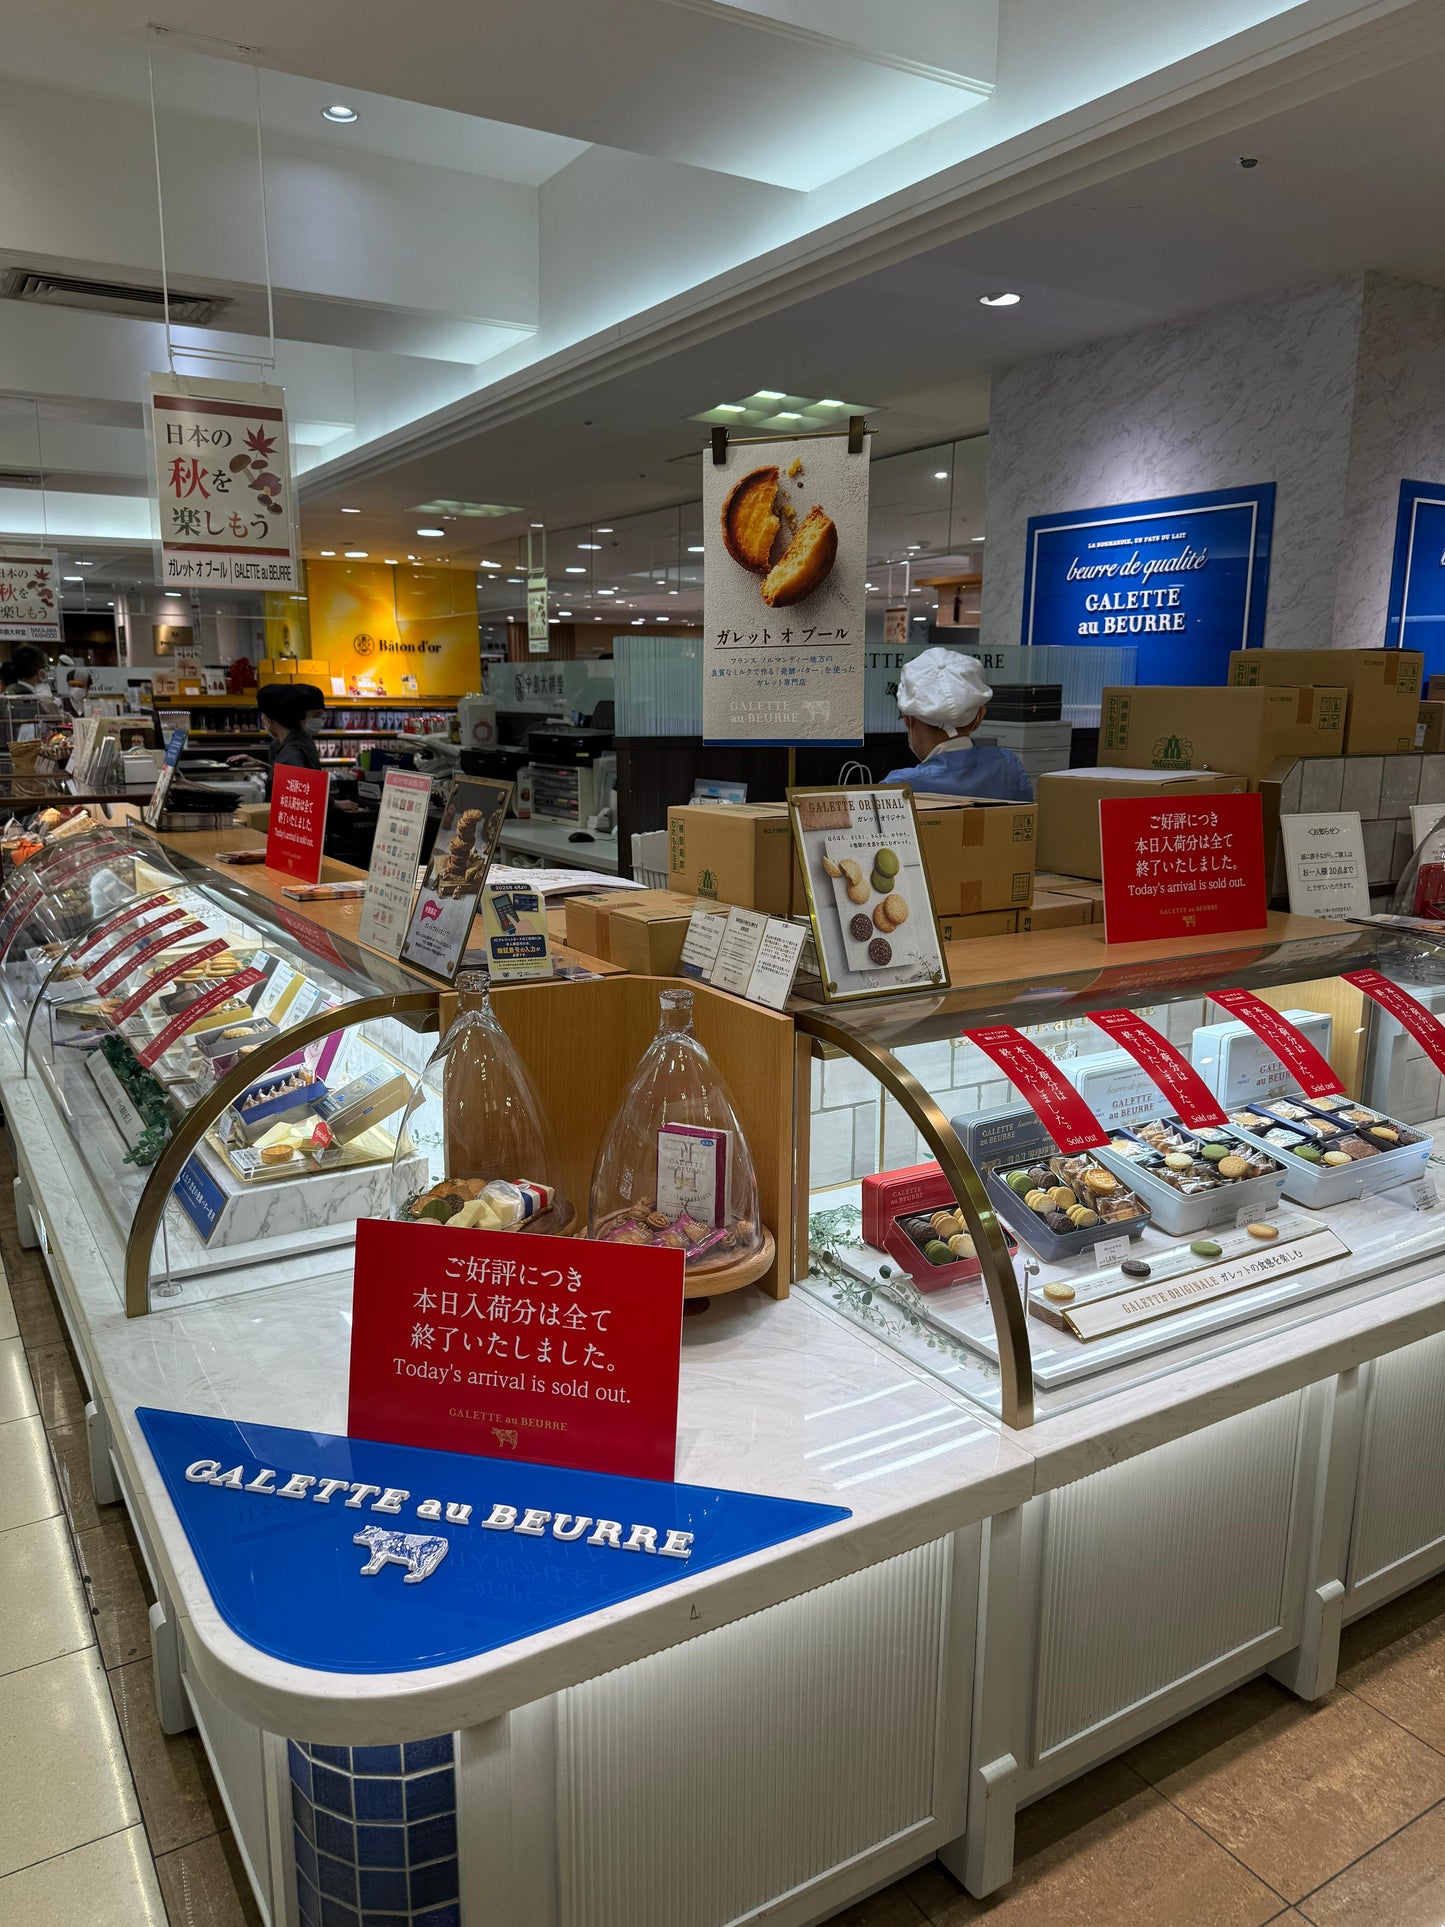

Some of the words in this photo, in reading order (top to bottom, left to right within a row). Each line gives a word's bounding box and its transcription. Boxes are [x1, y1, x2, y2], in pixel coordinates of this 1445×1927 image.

[166, 423, 232, 448] 日本の
[167, 456, 232, 499] 秋を
[172, 506, 269, 540] 楽しもう
[168, 559, 194, 577] ガレット
[196, 560, 203, 577] オ
[206, 560, 228, 578] ブール
[234, 563, 260, 580] GALETTE
[261, 567, 269, 580] au
[269, 565, 292, 581] BEURRE
[1066, 556, 1119, 581] beurre
[1119, 550, 1143, 576] de
[1142, 544, 1209, 584] qualité
[1084, 587, 1180, 612] GALETTE
[0, 605, 48, 619] 楽しもう
[1077, 619, 1099, 635] au
[1102, 612, 1186, 635] BEURRE
[379, 639, 416, 653] Bâton
[418, 640, 442, 653] d'or
[716, 628, 771, 646] ガレット
[781, 627, 793, 643] オ
[801, 626, 849, 643] ブール
[730, 701, 791, 711] GALETTE
[730, 715, 744, 723] au
[748, 712, 800, 723] BEURRE
[808, 800, 855, 813] GALETTE
[859, 798, 905, 811] ORGINAL
[1149, 811, 1218, 831] ご好評につき
[1134, 832, 1233, 855] 本日入荷分は全て
[1135, 854, 1238, 878] 終了いたしました。
[1128, 882, 1165, 897] Today's
[1167, 880, 1197, 893] arrival
[1199, 880, 1206, 890] is
[1208, 877, 1227, 890] sold
[1228, 878, 1246, 888] out.
[1252, 1006, 1306, 1054] 本日入荷分は
[1135, 1028, 1189, 1081] 本日入荷分は
[1240, 1007, 1315, 1079] 終了いたしました。
[1014, 1046, 1067, 1101] 本日入荷分は
[1121, 1030, 1196, 1109] 終了いたしました。
[998, 1047, 1072, 1130] 終了いたしました。
[1256, 1077, 1266, 1086] au
[1311, 1084, 1325, 1093] Sold
[1325, 1082, 1336, 1090] out
[1109, 1112, 1119, 1120] au
[1120, 1102, 1155, 1117] BEURRE
[1112, 1092, 1153, 1109] GALETTE
[1191, 1115, 1207, 1123] Sold
[1207, 1113, 1218, 1121] out
[981, 1123, 1015, 1138] GALETTE
[988, 1130, 1016, 1145] BEURRE
[1066, 1136, 1084, 1146] Sold
[1084, 1134, 1098, 1143] out
[444, 1255, 583, 1292] ご好評につき
[1121, 1292, 1168, 1314] GALETTE
[1167, 1274, 1219, 1300] ORIGINALE
[1219, 1249, 1303, 1282] ガレットの食感を楽しむ
[412, 1287, 612, 1332] 本日入荷分は全て
[409, 1322, 615, 1373] 終了いたしました。
[393, 1357, 462, 1384] Today's
[467, 1371, 525, 1391] arrival
[531, 1374, 546, 1393] is
[551, 1379, 589, 1398] sold
[595, 1386, 631, 1404] out.
[448, 1408, 502, 1423] GALETTE
[505, 1416, 519, 1425] au
[520, 1417, 568, 1432] BEURRE
[184, 1458, 411, 1514] GALETTE
[416, 1498, 472, 1525] au
[481, 1503, 695, 1560] BEURRE
